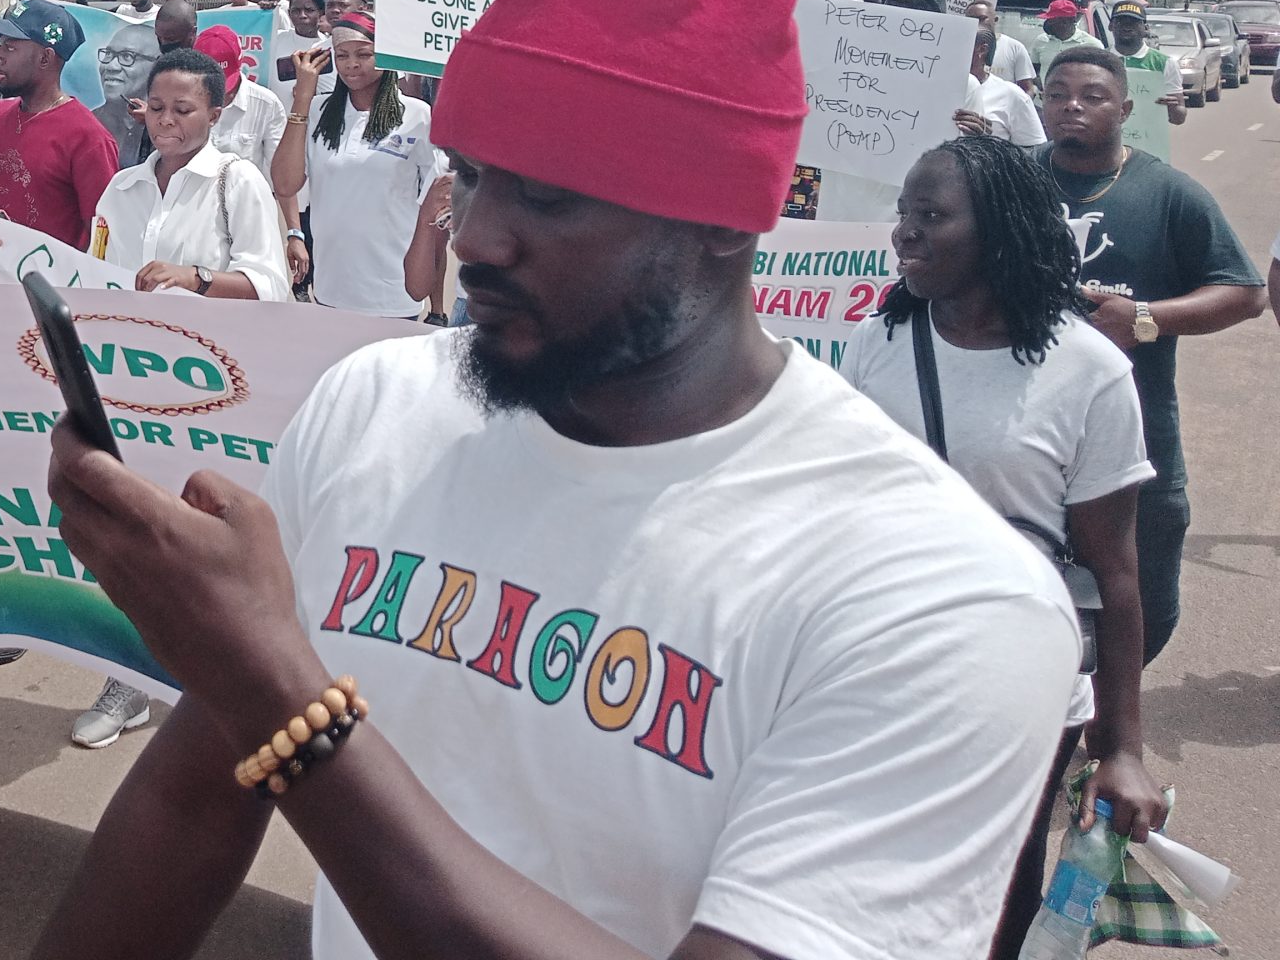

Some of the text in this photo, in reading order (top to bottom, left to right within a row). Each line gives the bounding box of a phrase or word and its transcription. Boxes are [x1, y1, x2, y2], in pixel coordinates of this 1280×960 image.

[953, 0, 968, 8] AND
[1116, 4, 1141, 14] ASHIA
[431, 11, 469, 31] GIVE
[825, 0, 944, 46] PETER OBI
[239, 36, 262, 50] UR
[834, 36, 940, 78] MOVEMENT
[838, 71, 887, 94] FOR
[805, 83, 920, 130] PRESIDENCY
[827, 120, 895, 155] (POMP)
[753, 249, 890, 276] BI NATIONAL
[751, 285, 831, 319] NAM
[1086, 279, 1133, 296] Smile
[110, 417, 176, 447] OR
[187, 427, 279, 466] PET
[320, 545, 724, 780] PARAGON
